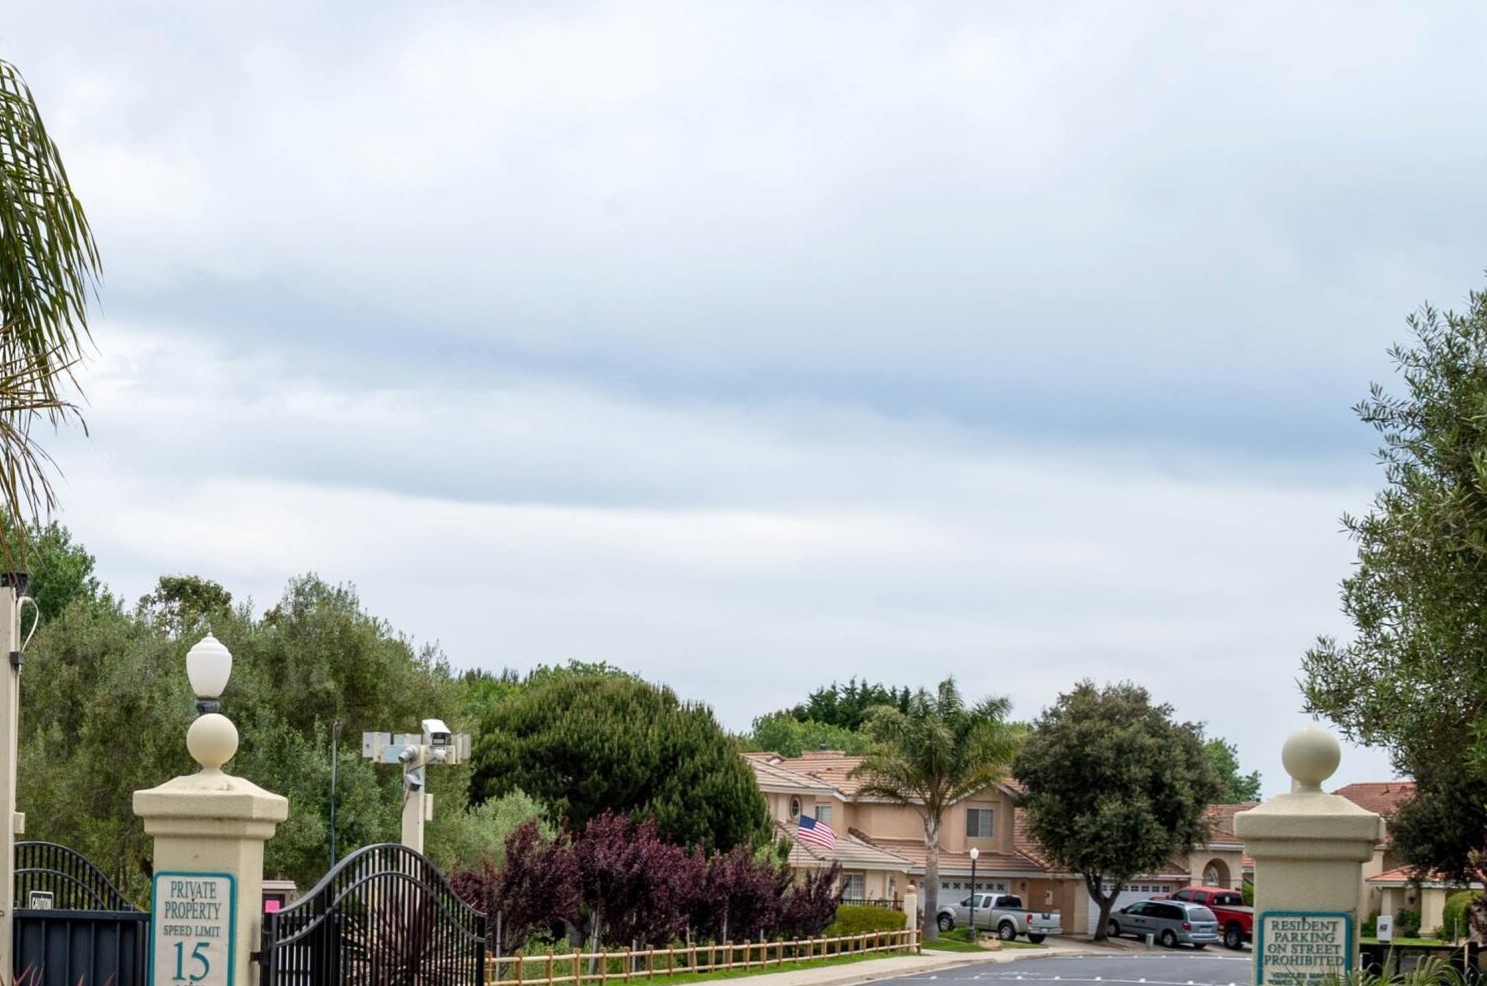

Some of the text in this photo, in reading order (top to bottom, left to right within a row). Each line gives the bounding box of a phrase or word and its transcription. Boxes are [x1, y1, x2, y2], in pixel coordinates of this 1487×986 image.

[170, 880, 217, 899] PRIVATE
[164, 901, 222, 920] PROPERTY
[163, 925, 221, 937] SPEED LIMIT
[1271, 920, 1339, 932] RESIDENT
[1274, 932, 1335, 943] PARKING
[1267, 943, 1341, 955] ON STREET
[172, 941, 210, 982] 15
[1264, 955, 1345, 966] PROHIBITED
